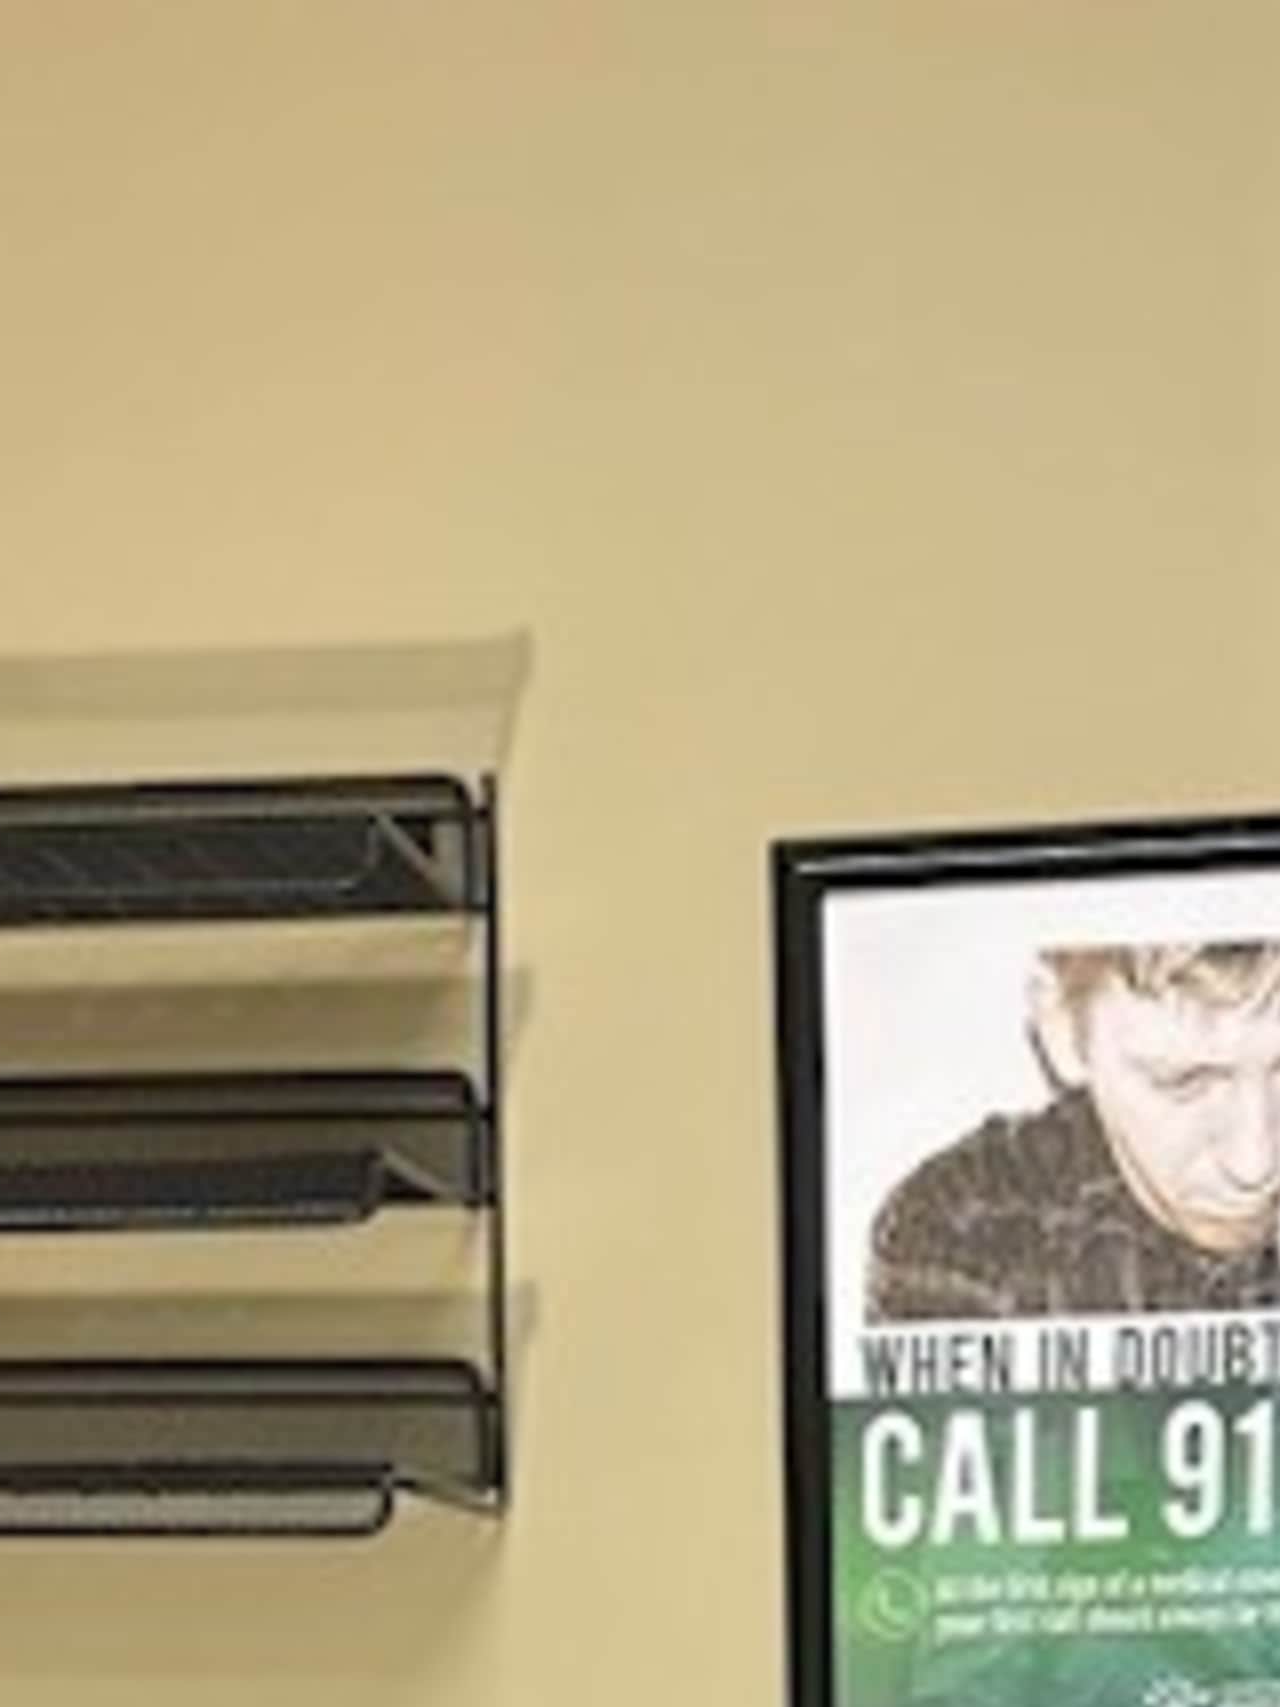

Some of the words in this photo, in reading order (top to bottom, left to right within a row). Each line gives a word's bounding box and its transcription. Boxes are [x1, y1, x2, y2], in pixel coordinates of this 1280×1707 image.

[859, 1334, 1013, 1394] WHEN
[1037, 1328, 1090, 1391] IN
[861, 1406, 1129, 1547] CALL
